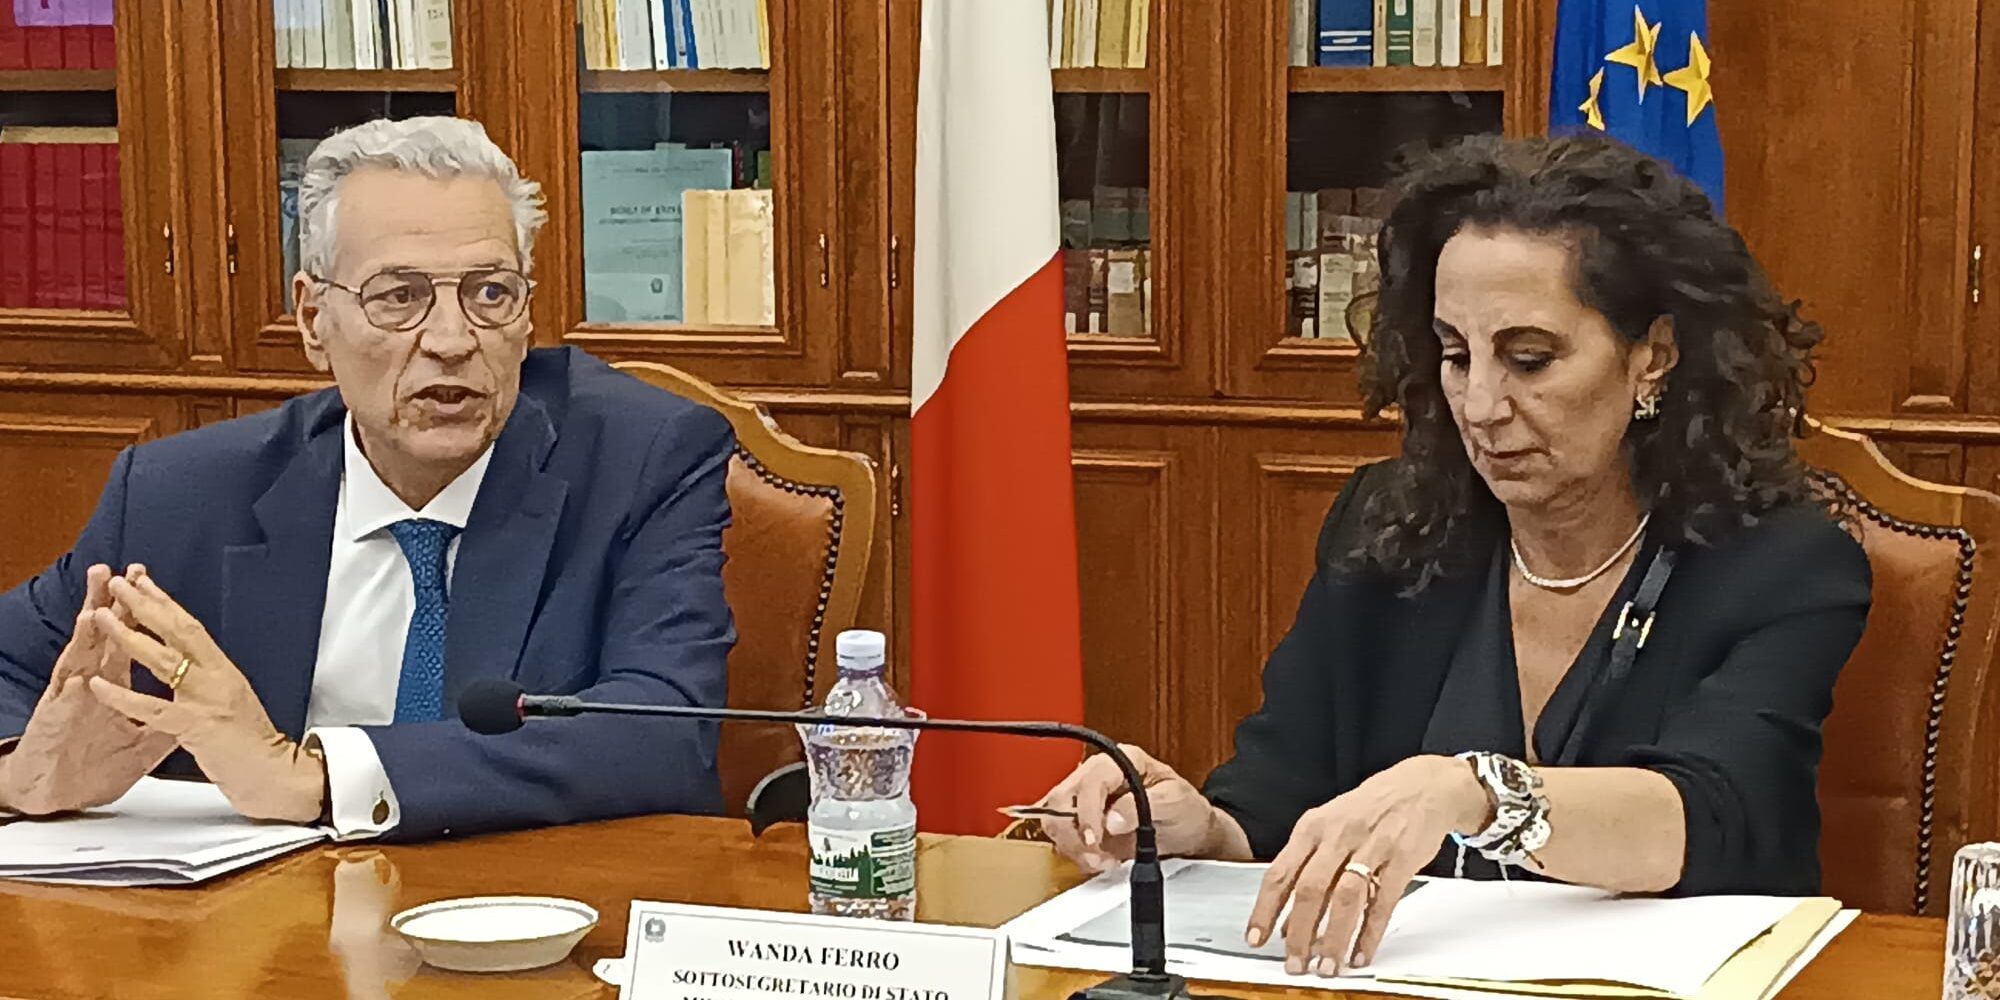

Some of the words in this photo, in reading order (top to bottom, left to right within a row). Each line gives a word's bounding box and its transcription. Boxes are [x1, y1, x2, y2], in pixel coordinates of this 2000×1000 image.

[728, 939, 813, 964] WANDA
[821, 946, 899, 971] FERRO
[673, 969, 856, 998] SOTTOSEGRETARIO
[862, 984, 881, 999] DI
